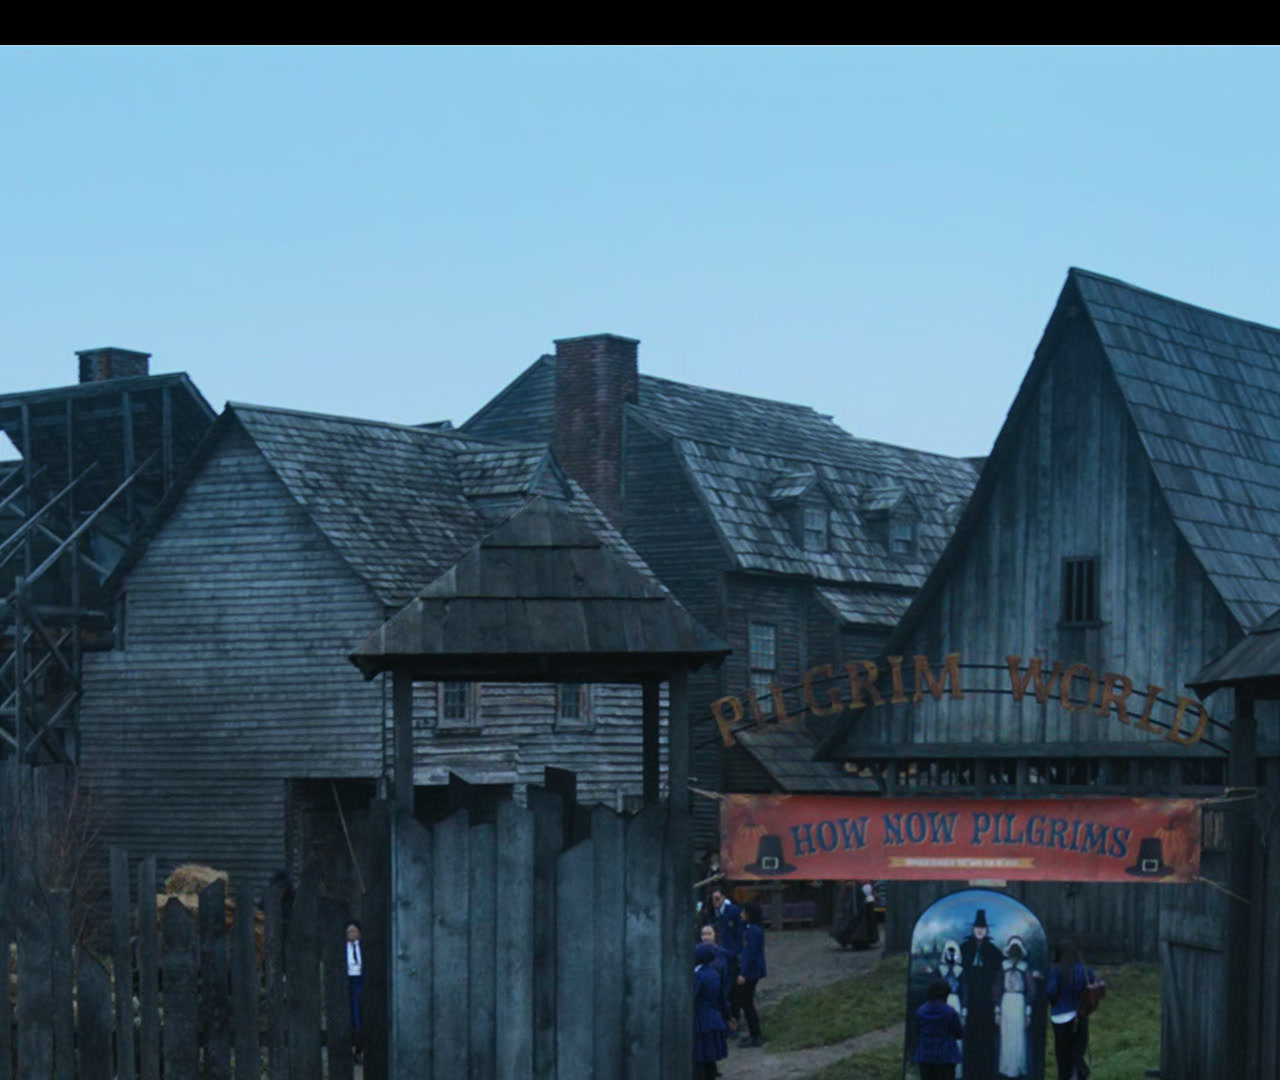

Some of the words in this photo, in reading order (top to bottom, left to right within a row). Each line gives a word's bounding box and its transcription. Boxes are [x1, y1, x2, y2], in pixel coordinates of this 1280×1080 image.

[711, 652, 964, 748] PILGRIM
[1007, 654, 1209, 746] WORLD
[790, 815, 869, 857] HOW
[882, 811, 959, 847] NOW
[971, 812, 1132, 859] PILGRIMS
